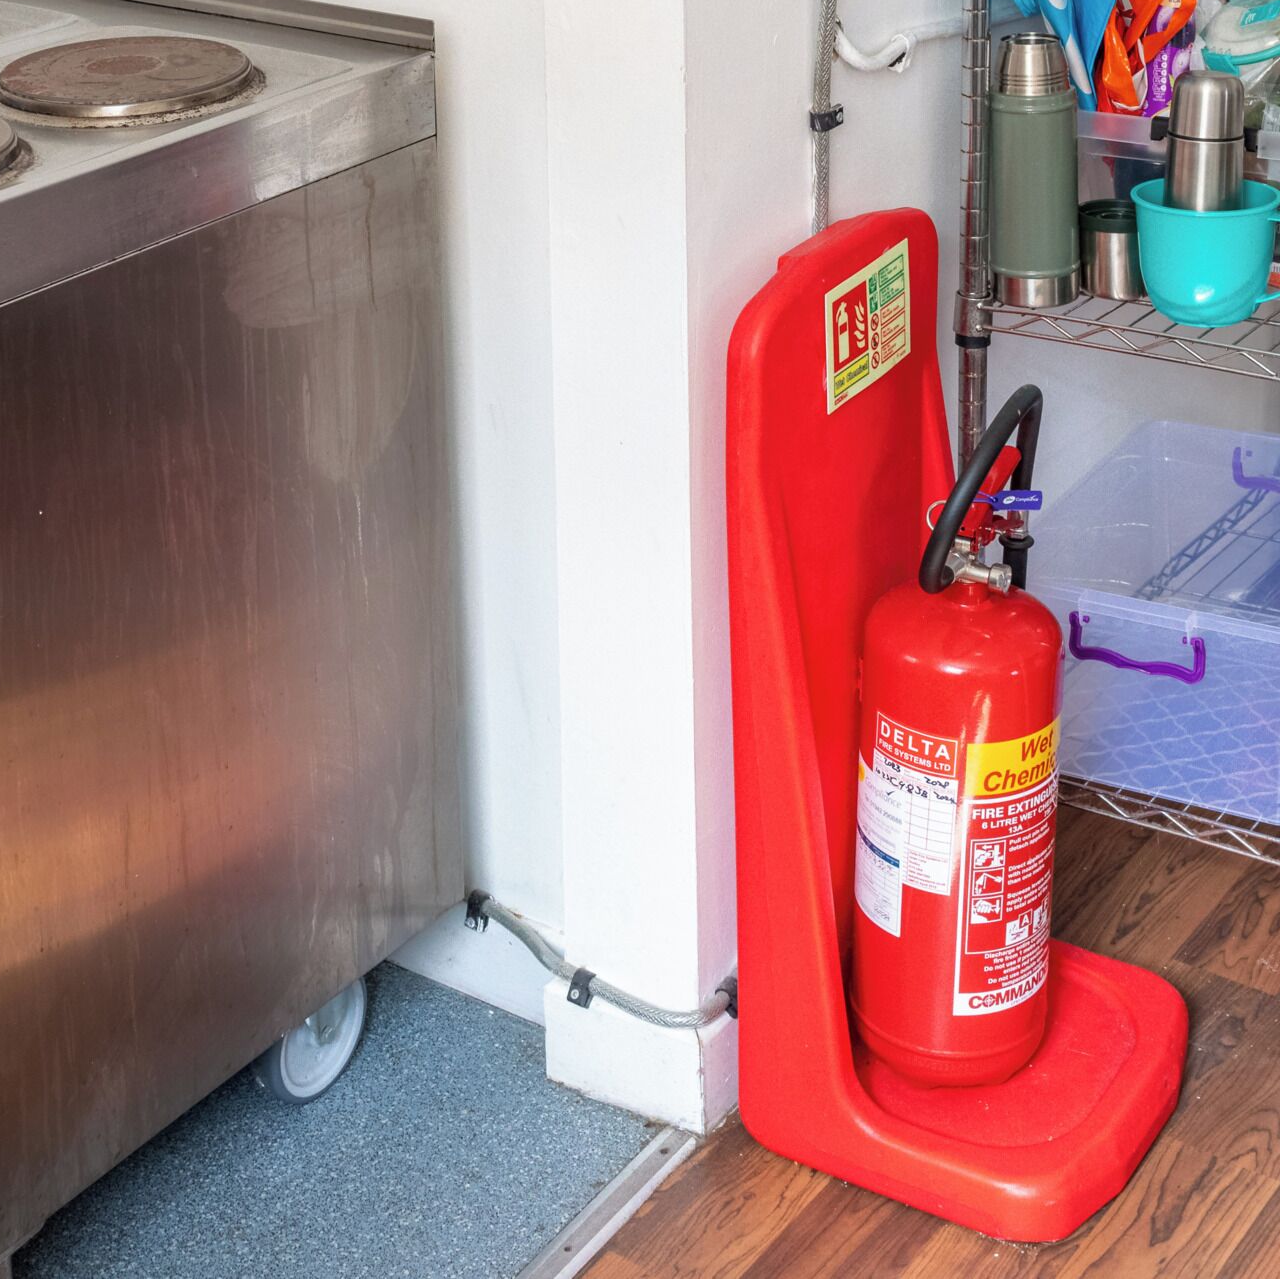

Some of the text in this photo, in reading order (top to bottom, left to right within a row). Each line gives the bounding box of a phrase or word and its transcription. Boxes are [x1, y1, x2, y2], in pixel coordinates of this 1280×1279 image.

[881, 720, 951, 760] DELTA
[1022, 728, 1053, 761] Wet
[879, 738, 951, 772] FIRE SYSTEMS LTD
[972, 807, 1005, 819] FIRE
[991, 817, 1018, 829] LITRE
[1020, 809, 1037, 822] WET
[1008, 825, 1023, 834] 13A
[1021, 914, 1029, 927] A
[984, 948, 1015, 959] Discharge
